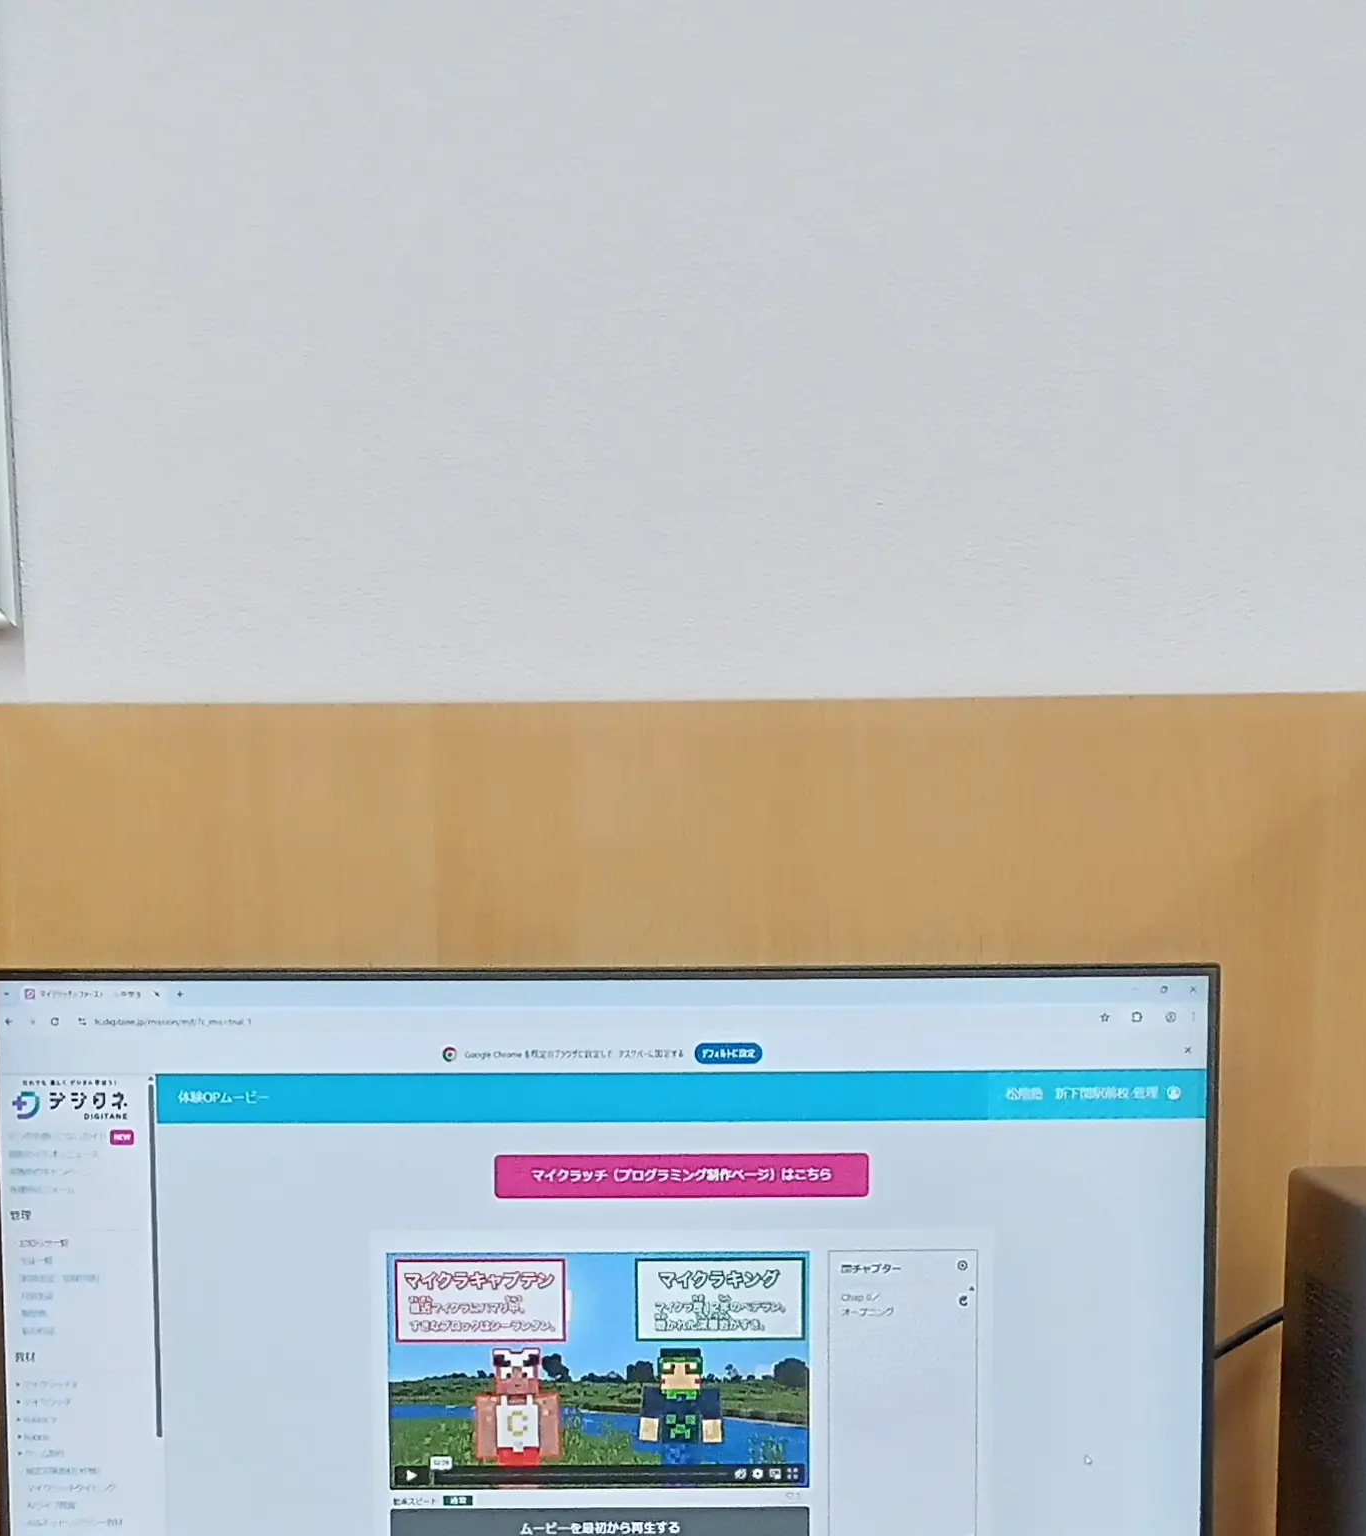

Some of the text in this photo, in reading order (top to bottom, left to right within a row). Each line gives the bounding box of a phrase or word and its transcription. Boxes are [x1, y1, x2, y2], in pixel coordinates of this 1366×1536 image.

[49, 1091, 128, 1110] デジタネ
[113, 1133, 132, 1141] NEW
[658, 1269, 781, 1289] マイクラキング
[520, 1520, 681, 1536] ムービーを最初から再生する
